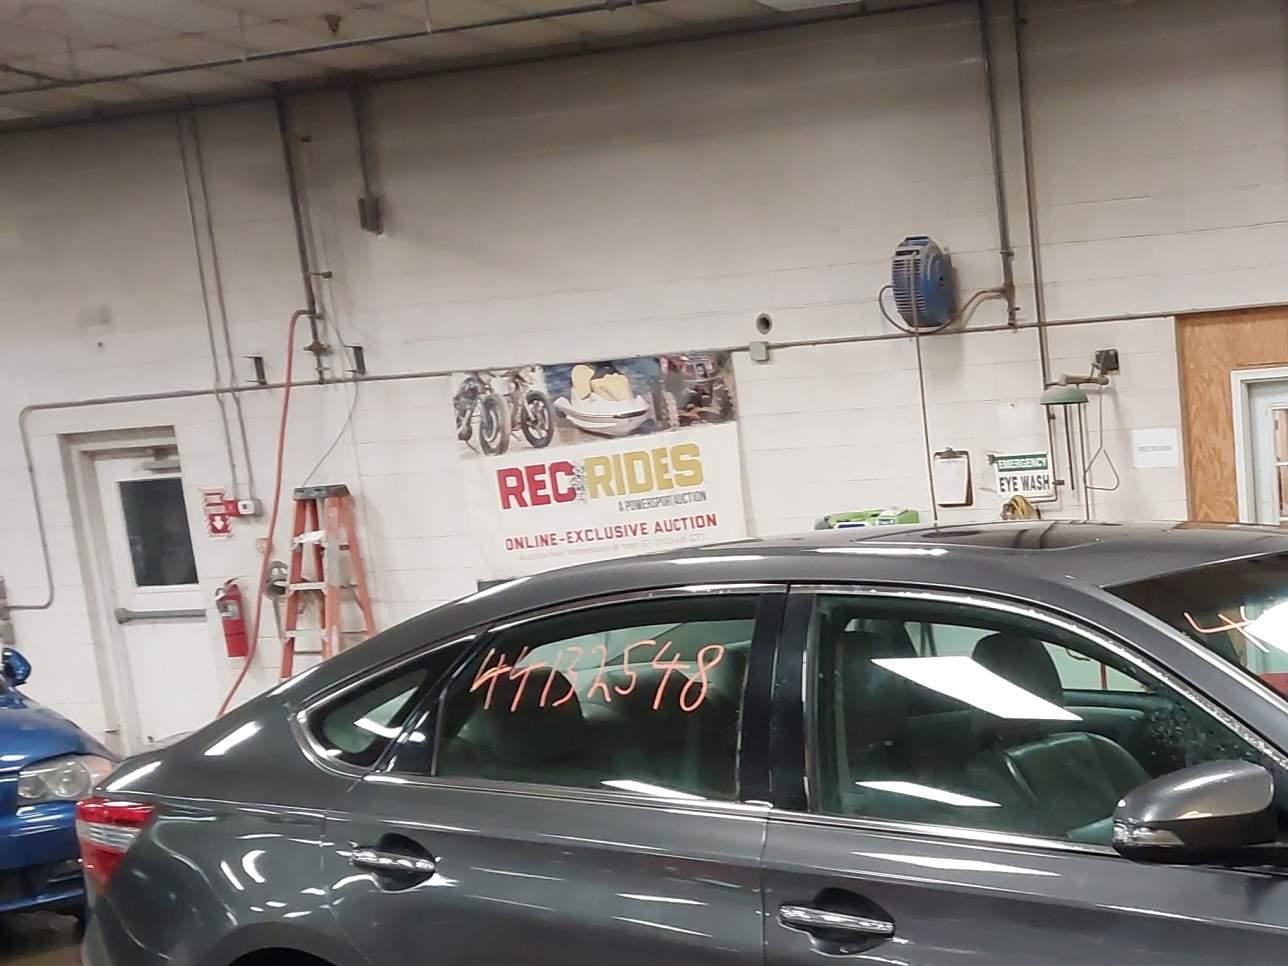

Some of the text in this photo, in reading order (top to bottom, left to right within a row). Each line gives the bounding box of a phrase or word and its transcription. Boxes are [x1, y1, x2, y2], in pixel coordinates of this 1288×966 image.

[496, 461, 577, 509] REC
[584, 443, 704, 498] RIDES
[997, 458, 1047, 468] EMERGENCY
[1000, 475, 1049, 492] EYE WASH
[505, 522, 648, 551] ONLINE-EXCLUSIVE
[654, 514, 718, 533] AUCTION
